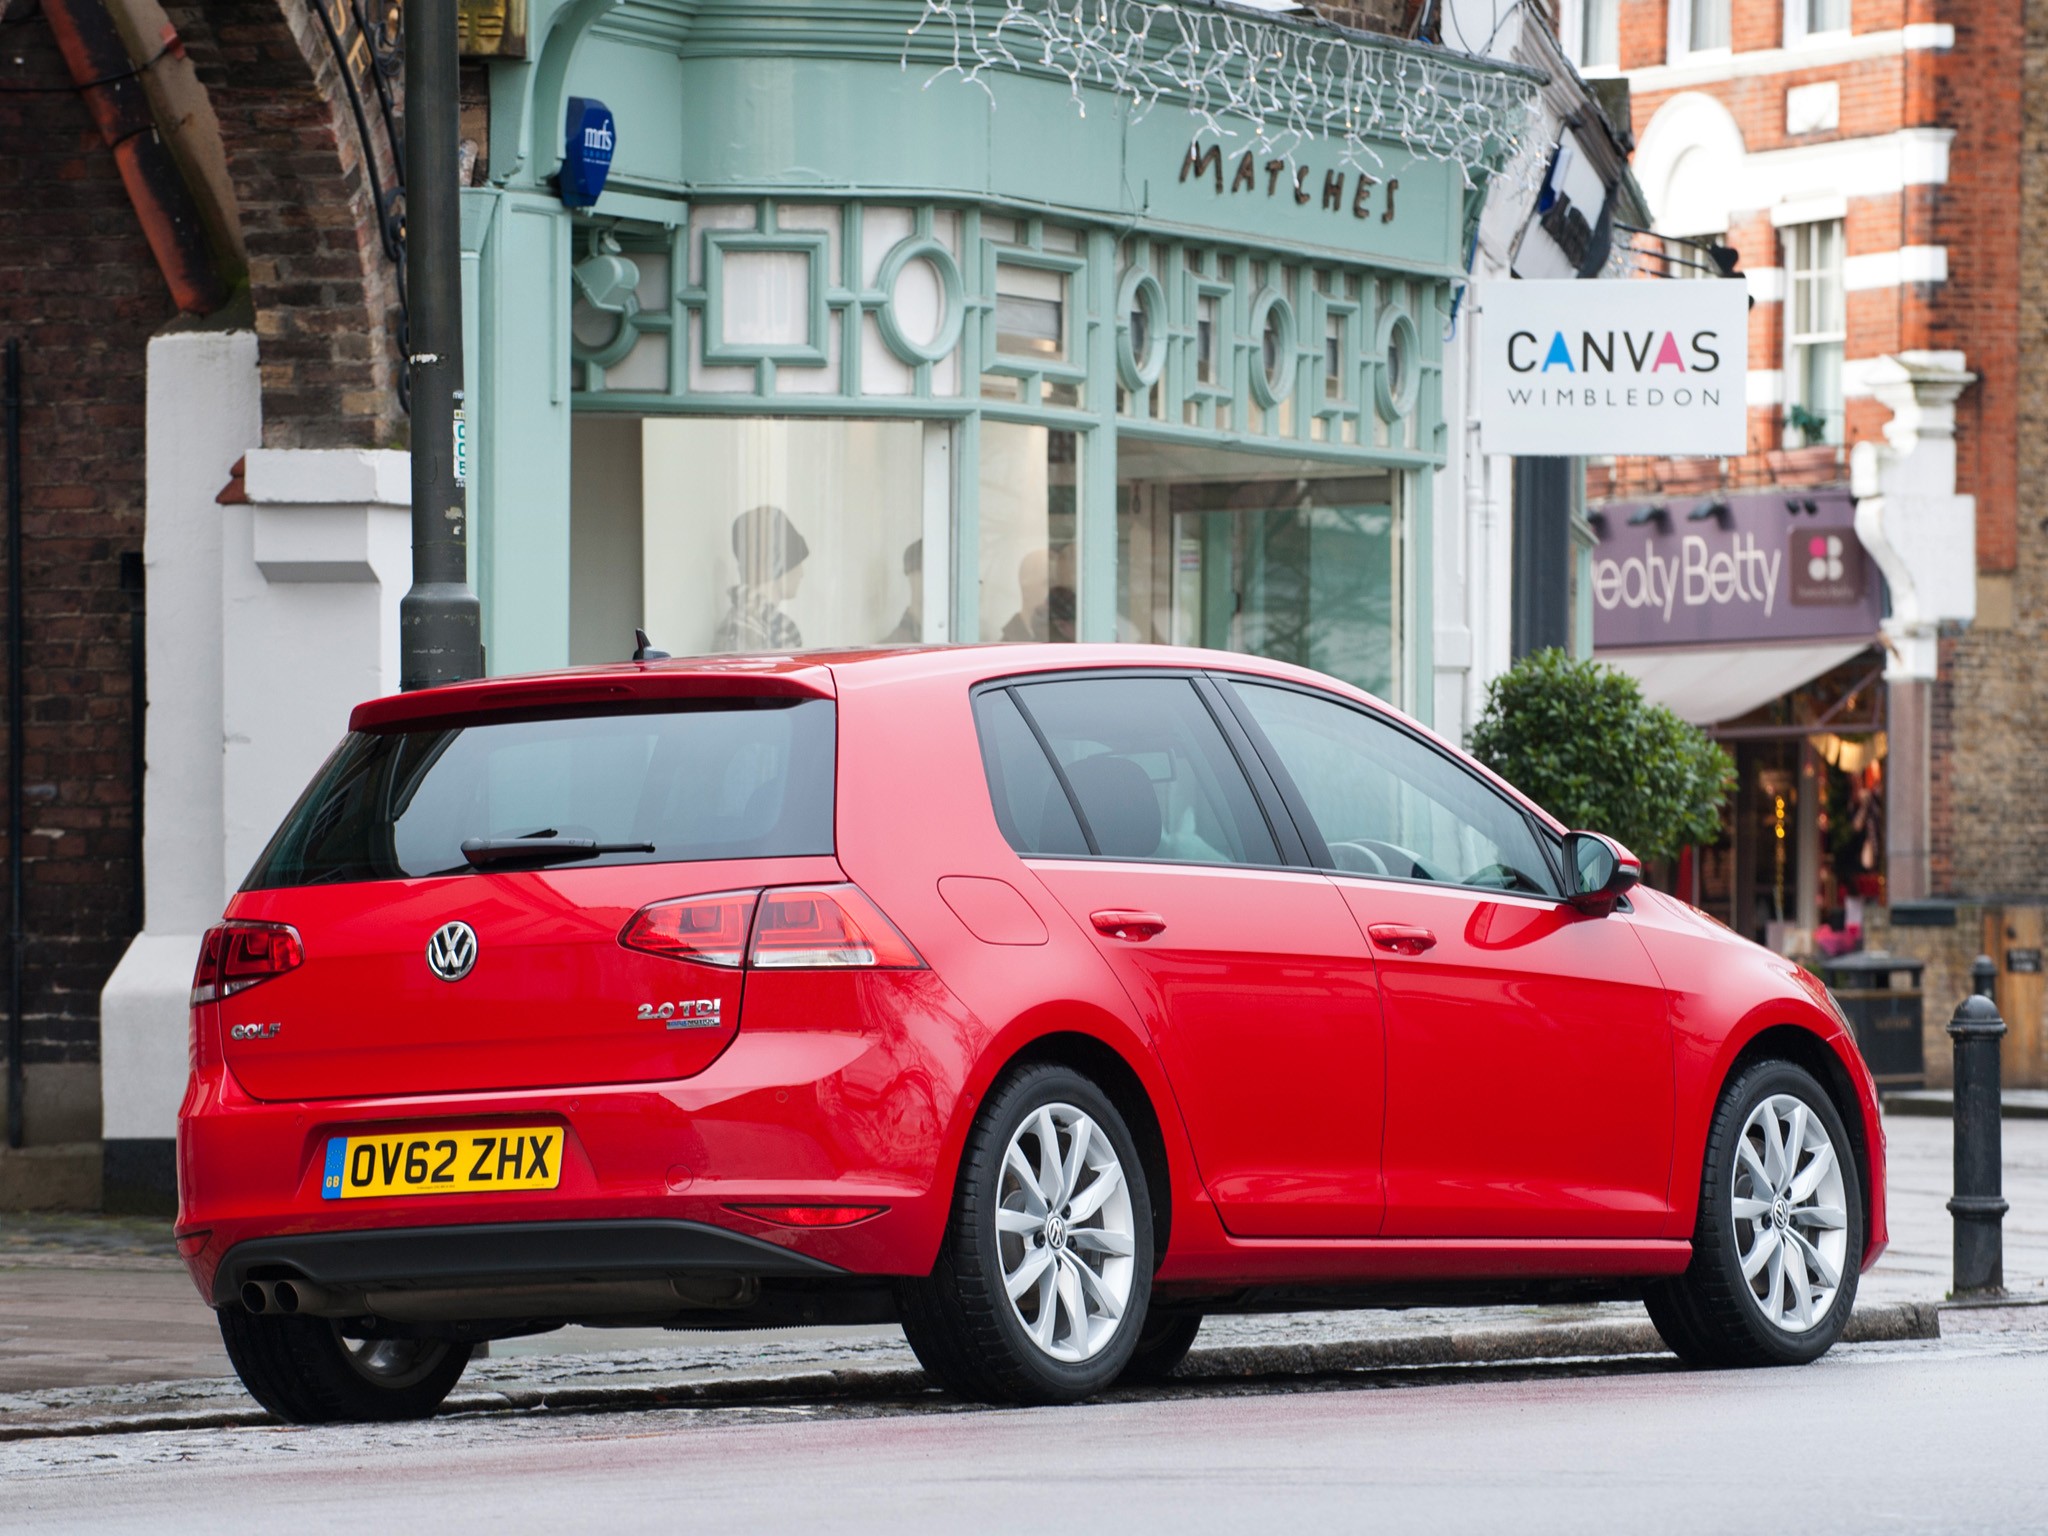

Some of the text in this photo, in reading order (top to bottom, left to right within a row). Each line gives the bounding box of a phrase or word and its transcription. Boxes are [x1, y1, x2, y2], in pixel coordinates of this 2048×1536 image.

[1179, 140, 1399, 224] MATCHES
[1507, 331, 1720, 373] CANVAS
[1507, 388, 1720, 406] WIMBLEDON
[637, 998, 721, 1020] 2.0 TDI
[231, 1022, 281, 1040] GOLF
[350, 1135, 554, 1188] OV62 ZHX
[326, 1175, 340, 1188] GB
